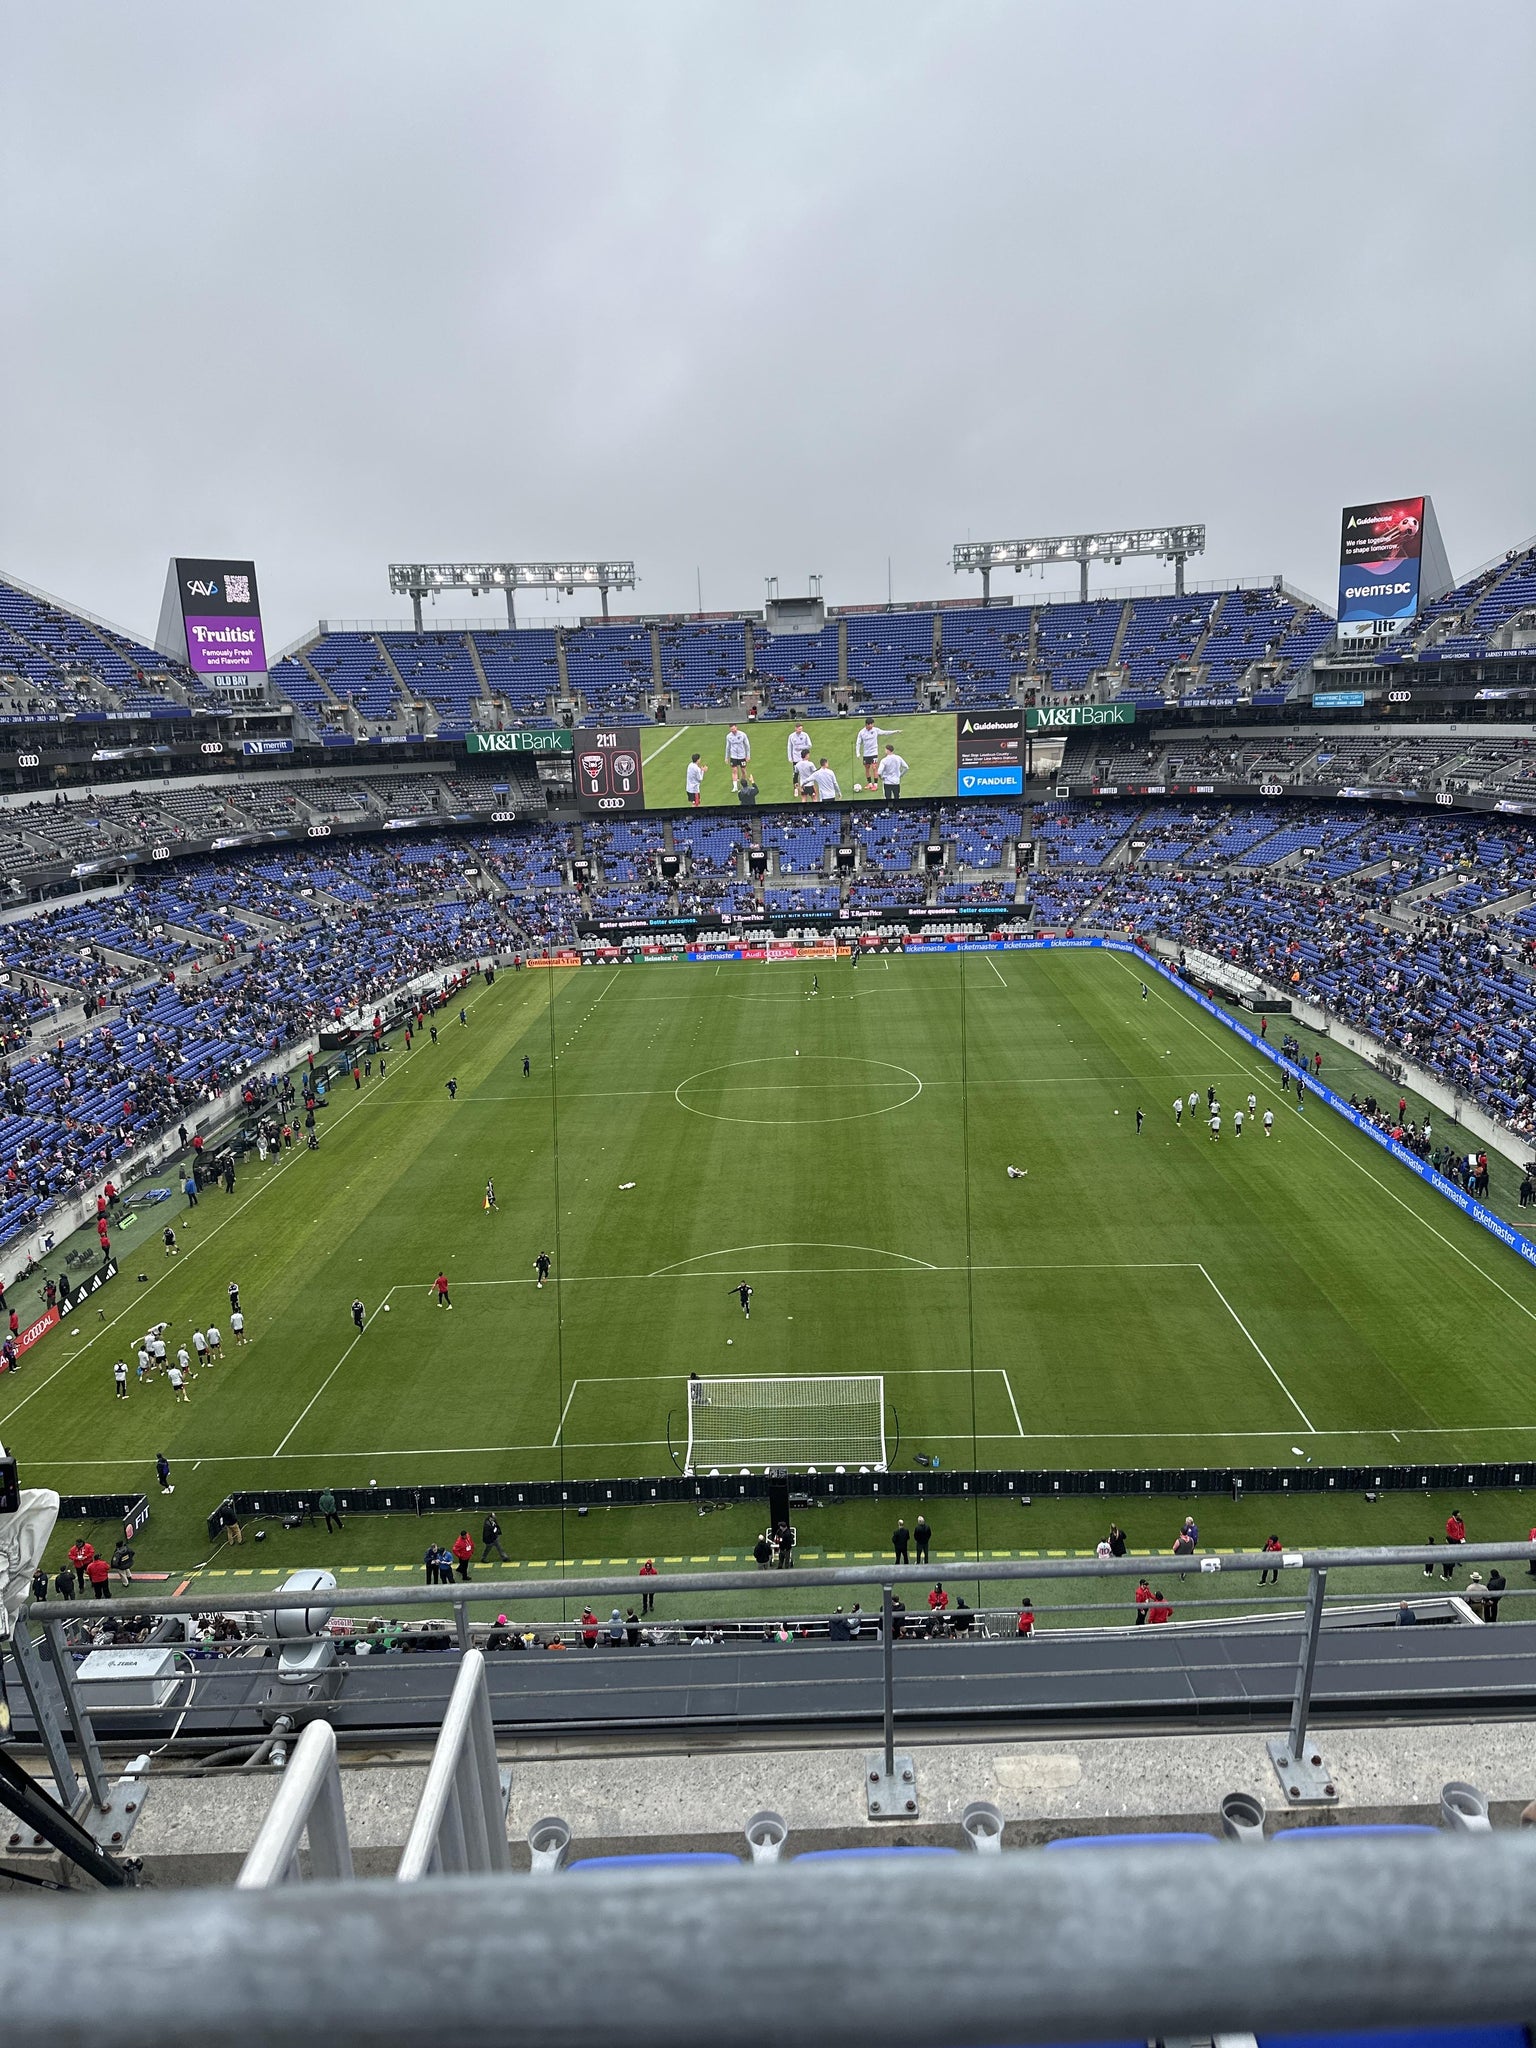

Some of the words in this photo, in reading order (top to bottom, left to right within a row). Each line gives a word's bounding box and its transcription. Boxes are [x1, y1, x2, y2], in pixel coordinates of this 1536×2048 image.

[1356, 515, 1393, 526] Guidehouse
[1394, 582, 1411, 594] DC
[192, 626, 256, 643] Fruitist
[1372, 620, 1396, 636] Lite
[202, 649, 234, 657] Famously
[234, 648, 253, 656] Fresh
[216, 676, 232, 686] OLD
[232, 676, 248, 686] BAY
[1036, 708, 1080, 726] M&T
[1082, 706, 1124, 724] Bank
[973, 722, 1018, 730] Guidehouse
[476, 734, 520, 752] M&T
[522, 732, 562, 750] Bank
[596, 734, 616, 748] 21:11
[592, 780, 598, 792] 0
[623, 778, 630, 791] 0
[977, 777, 1018, 786] FANDUEL
[1004, 940, 1045, 949] ticketmaster
[1102, 940, 1134, 951] ticketmaster
[1330, 1096, 1356, 1122] ticketmaster
[1359, 1118, 1388, 1146] ticketmaster
[1392, 1142, 1424, 1174] ticketmaster
[1431, 1173, 1468, 1208] ticketmaster
[1473, 1206, 1516, 1246] ticketmaster
[136, 1505, 150, 1530] FIT
[1100, 1548, 1110, 1556] 10
